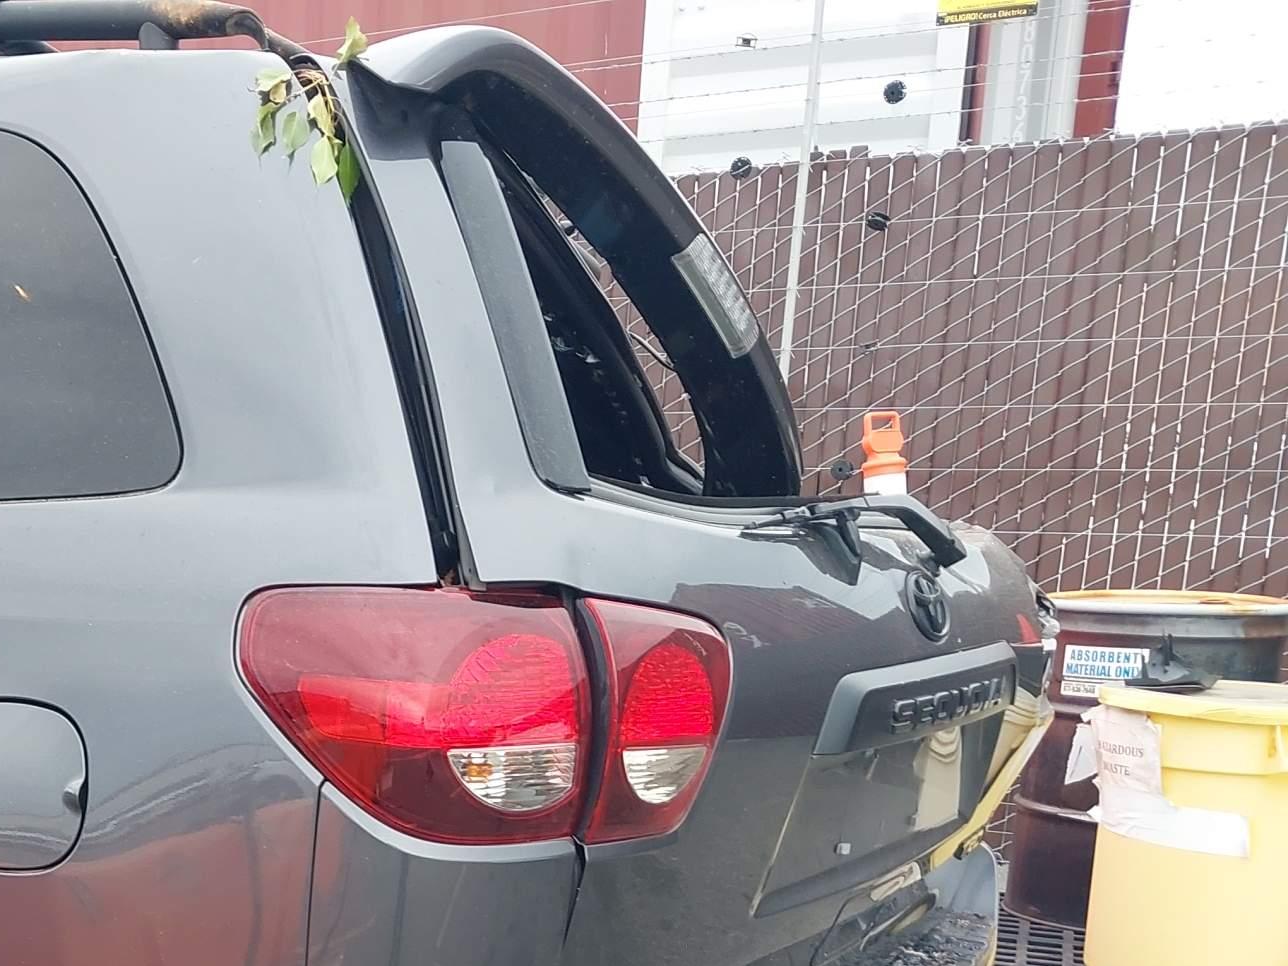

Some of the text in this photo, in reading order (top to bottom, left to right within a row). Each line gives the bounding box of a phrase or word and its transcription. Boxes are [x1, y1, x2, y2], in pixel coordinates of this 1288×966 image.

[1070, 649, 1140, 664] ABSORBENT
[1065, 662, 1111, 677] MATERIAL
[891, 677, 1002, 733] SEQUOIA
